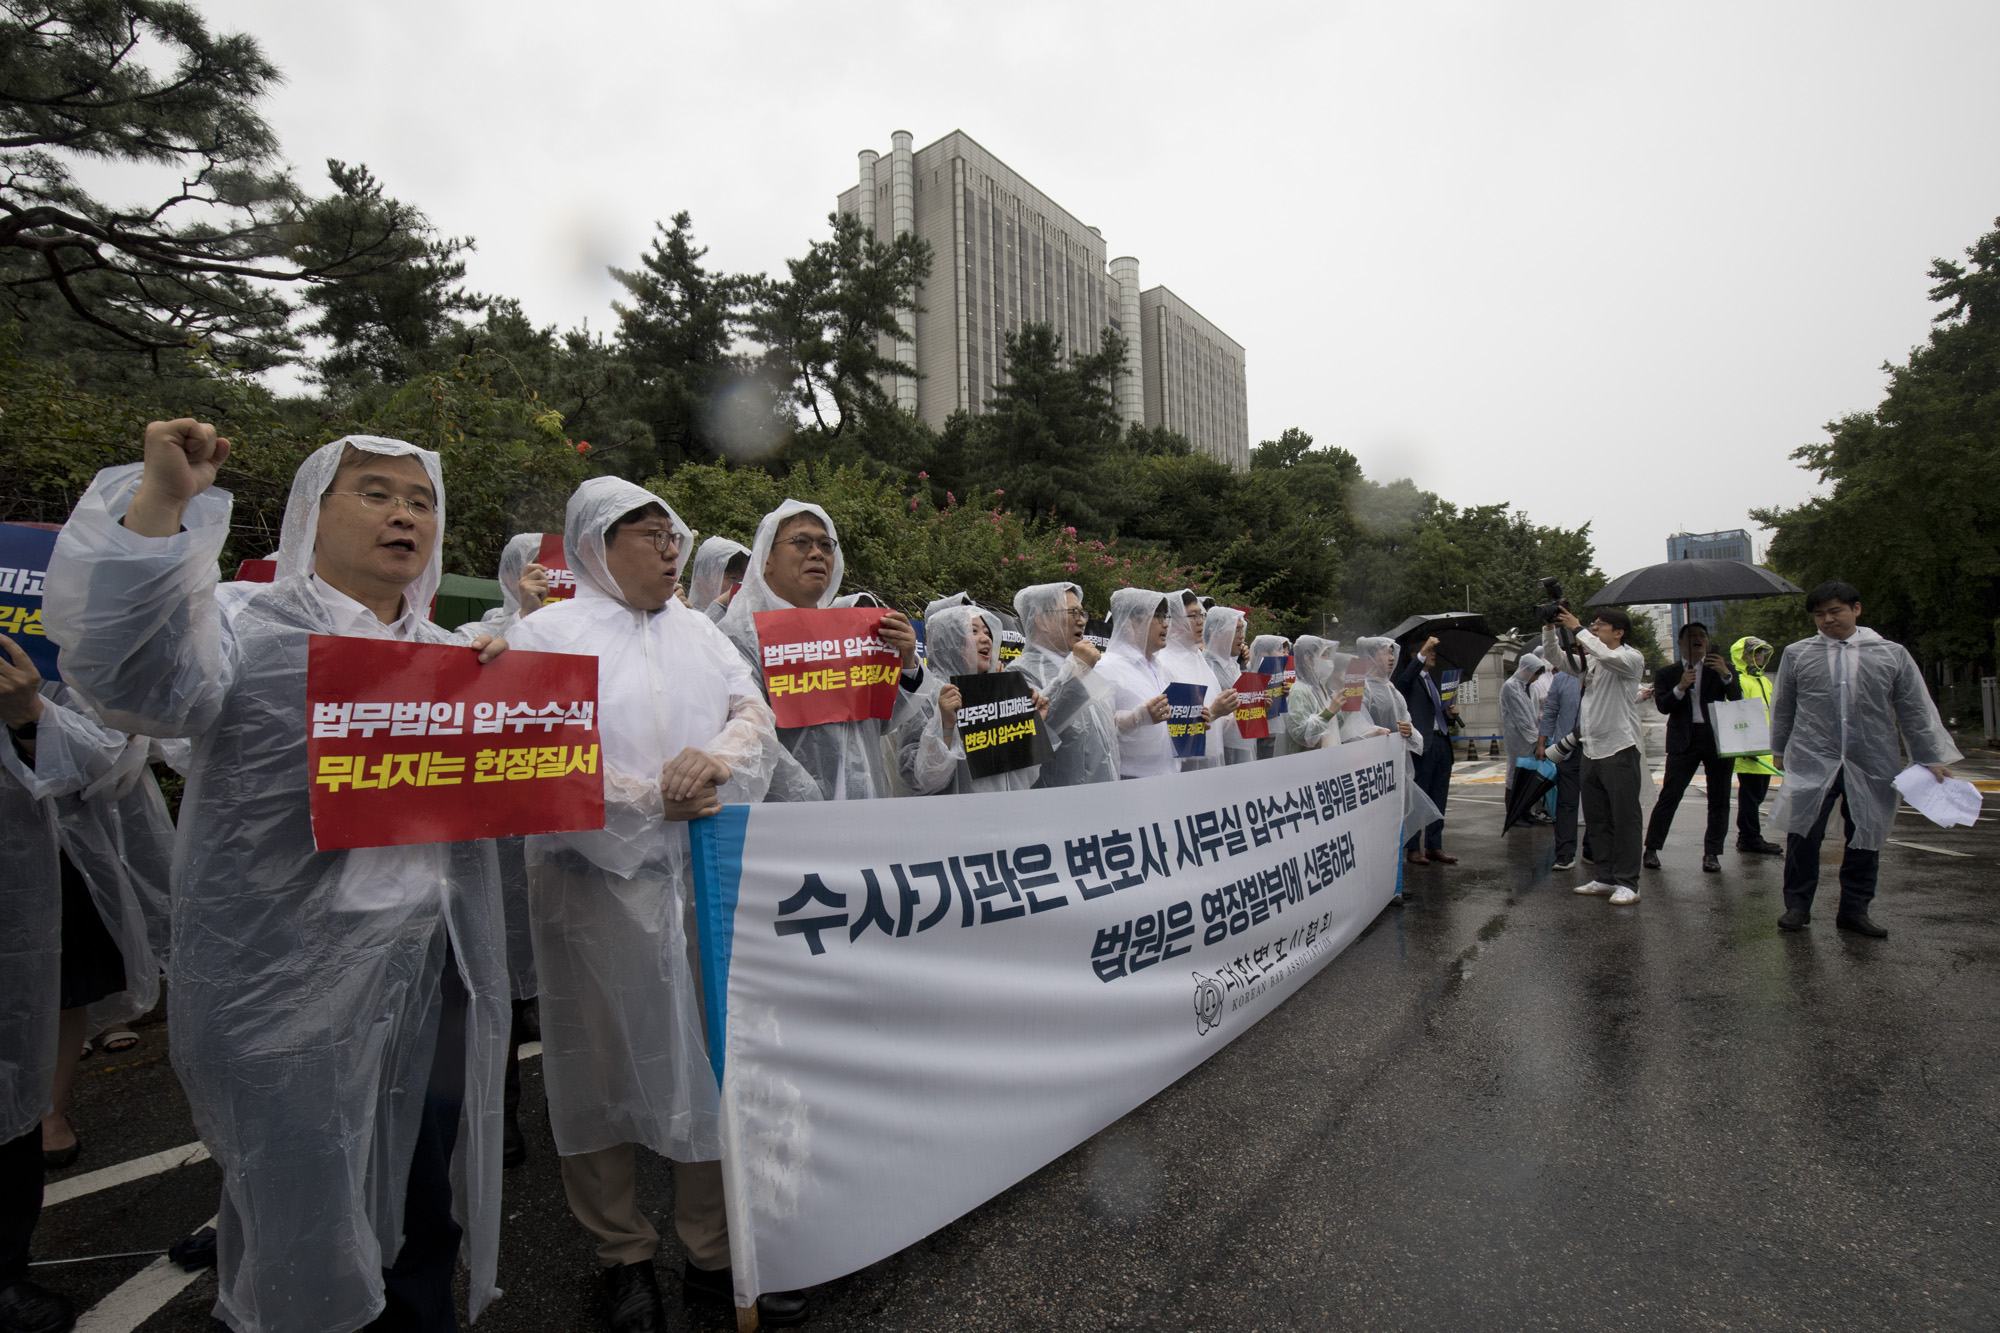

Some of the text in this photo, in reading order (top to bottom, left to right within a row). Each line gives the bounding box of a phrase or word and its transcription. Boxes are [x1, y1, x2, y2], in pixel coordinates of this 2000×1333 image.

[764, 639, 841, 667] 법무법인
[769, 668, 846, 697] 무너지는
[312, 701, 595, 738] 법무법인 압수수색
[957, 696, 1035, 728] 민주주의 파괴하는
[965, 718, 1037, 753] 변호사 압수수색
[316, 744, 599, 792] 무너지는 헌정질서
[774, 843, 1069, 956] 수사기관은
[1064, 822, 1171, 901] 변호사
[1174, 803, 1248, 870] 사무실
[1245, 785, 1319, 848] 압수수색
[1315, 772, 1357, 822] 행위를
[1091, 830, 1356, 984] 법원은 영장발부에 신중하라
[1216, 910, 1333, 992] 대한변호사협회
[1231, 935, 1333, 1012] KOREAN BAR ASSOCIATION
